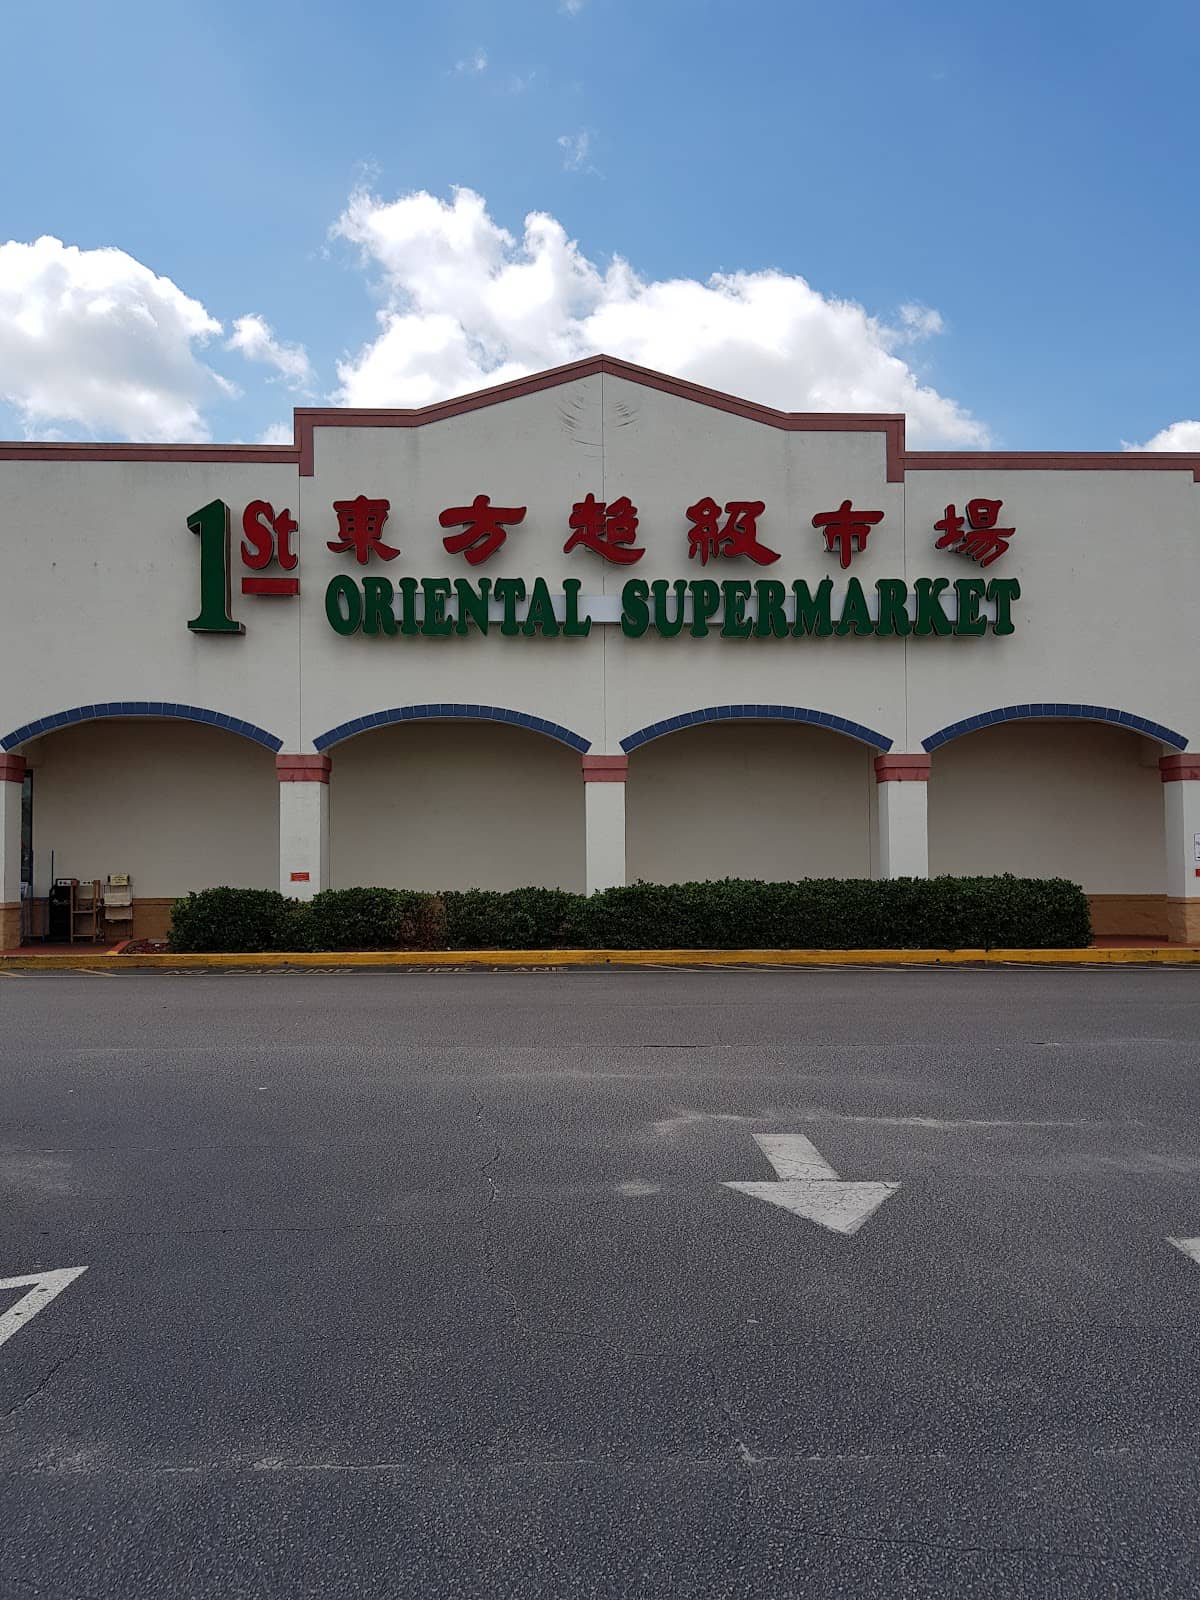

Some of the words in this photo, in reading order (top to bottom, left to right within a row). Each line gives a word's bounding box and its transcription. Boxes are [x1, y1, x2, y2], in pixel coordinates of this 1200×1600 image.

[326, 493, 1016, 568] 東方超級市場
[325, 574, 592, 637] ORIENTAL
[620, 577, 1021, 638] SUPERMARKET
[222, 967, 353, 975] PARKING
